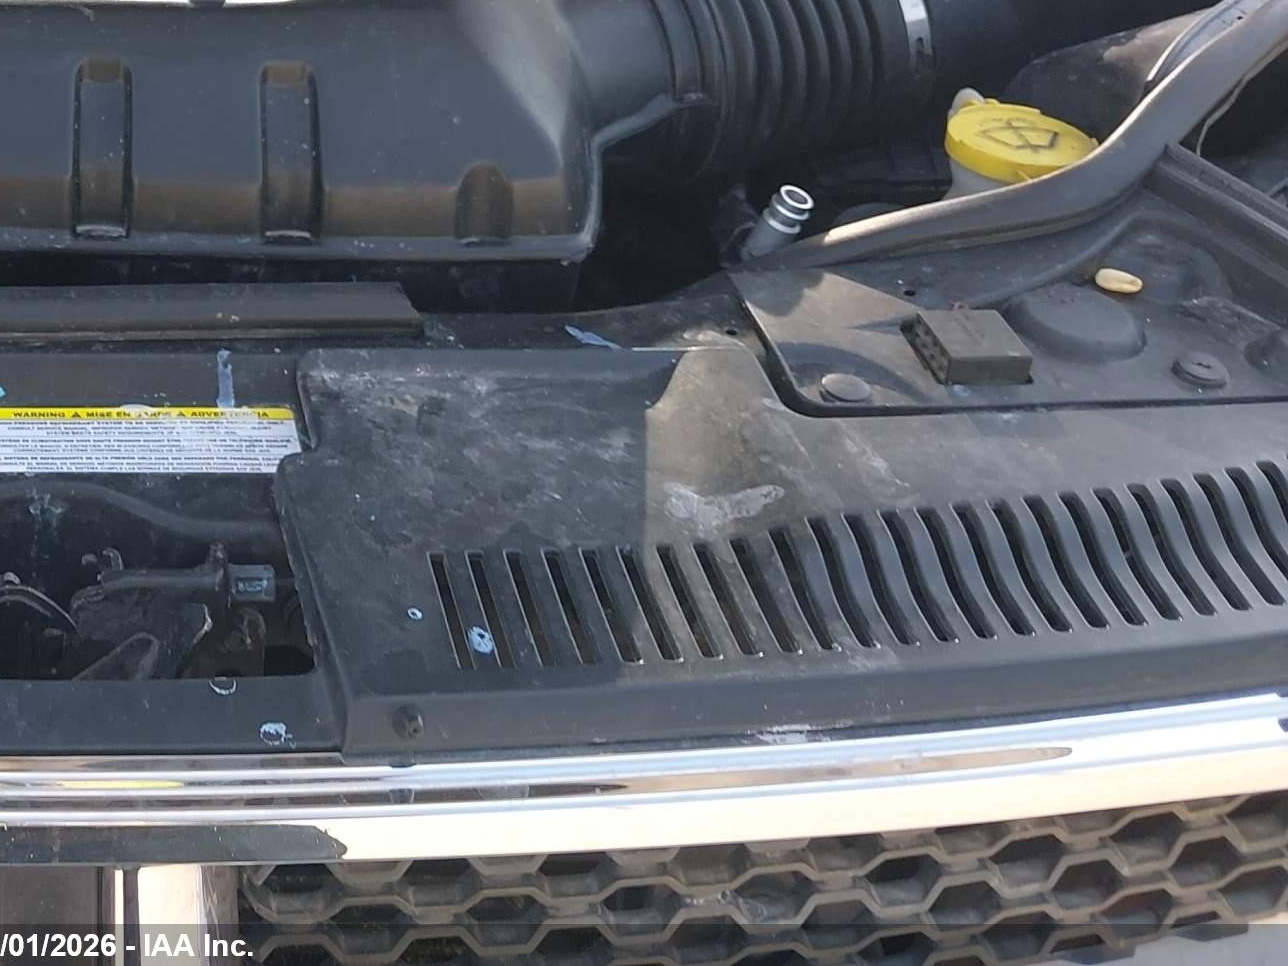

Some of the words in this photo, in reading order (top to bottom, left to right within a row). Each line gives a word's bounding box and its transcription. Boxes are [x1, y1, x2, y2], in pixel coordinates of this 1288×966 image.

[12, 411, 66, 419] WARNING
[85, 411, 113, 419] MISE
[115, 411, 131, 419] EN
